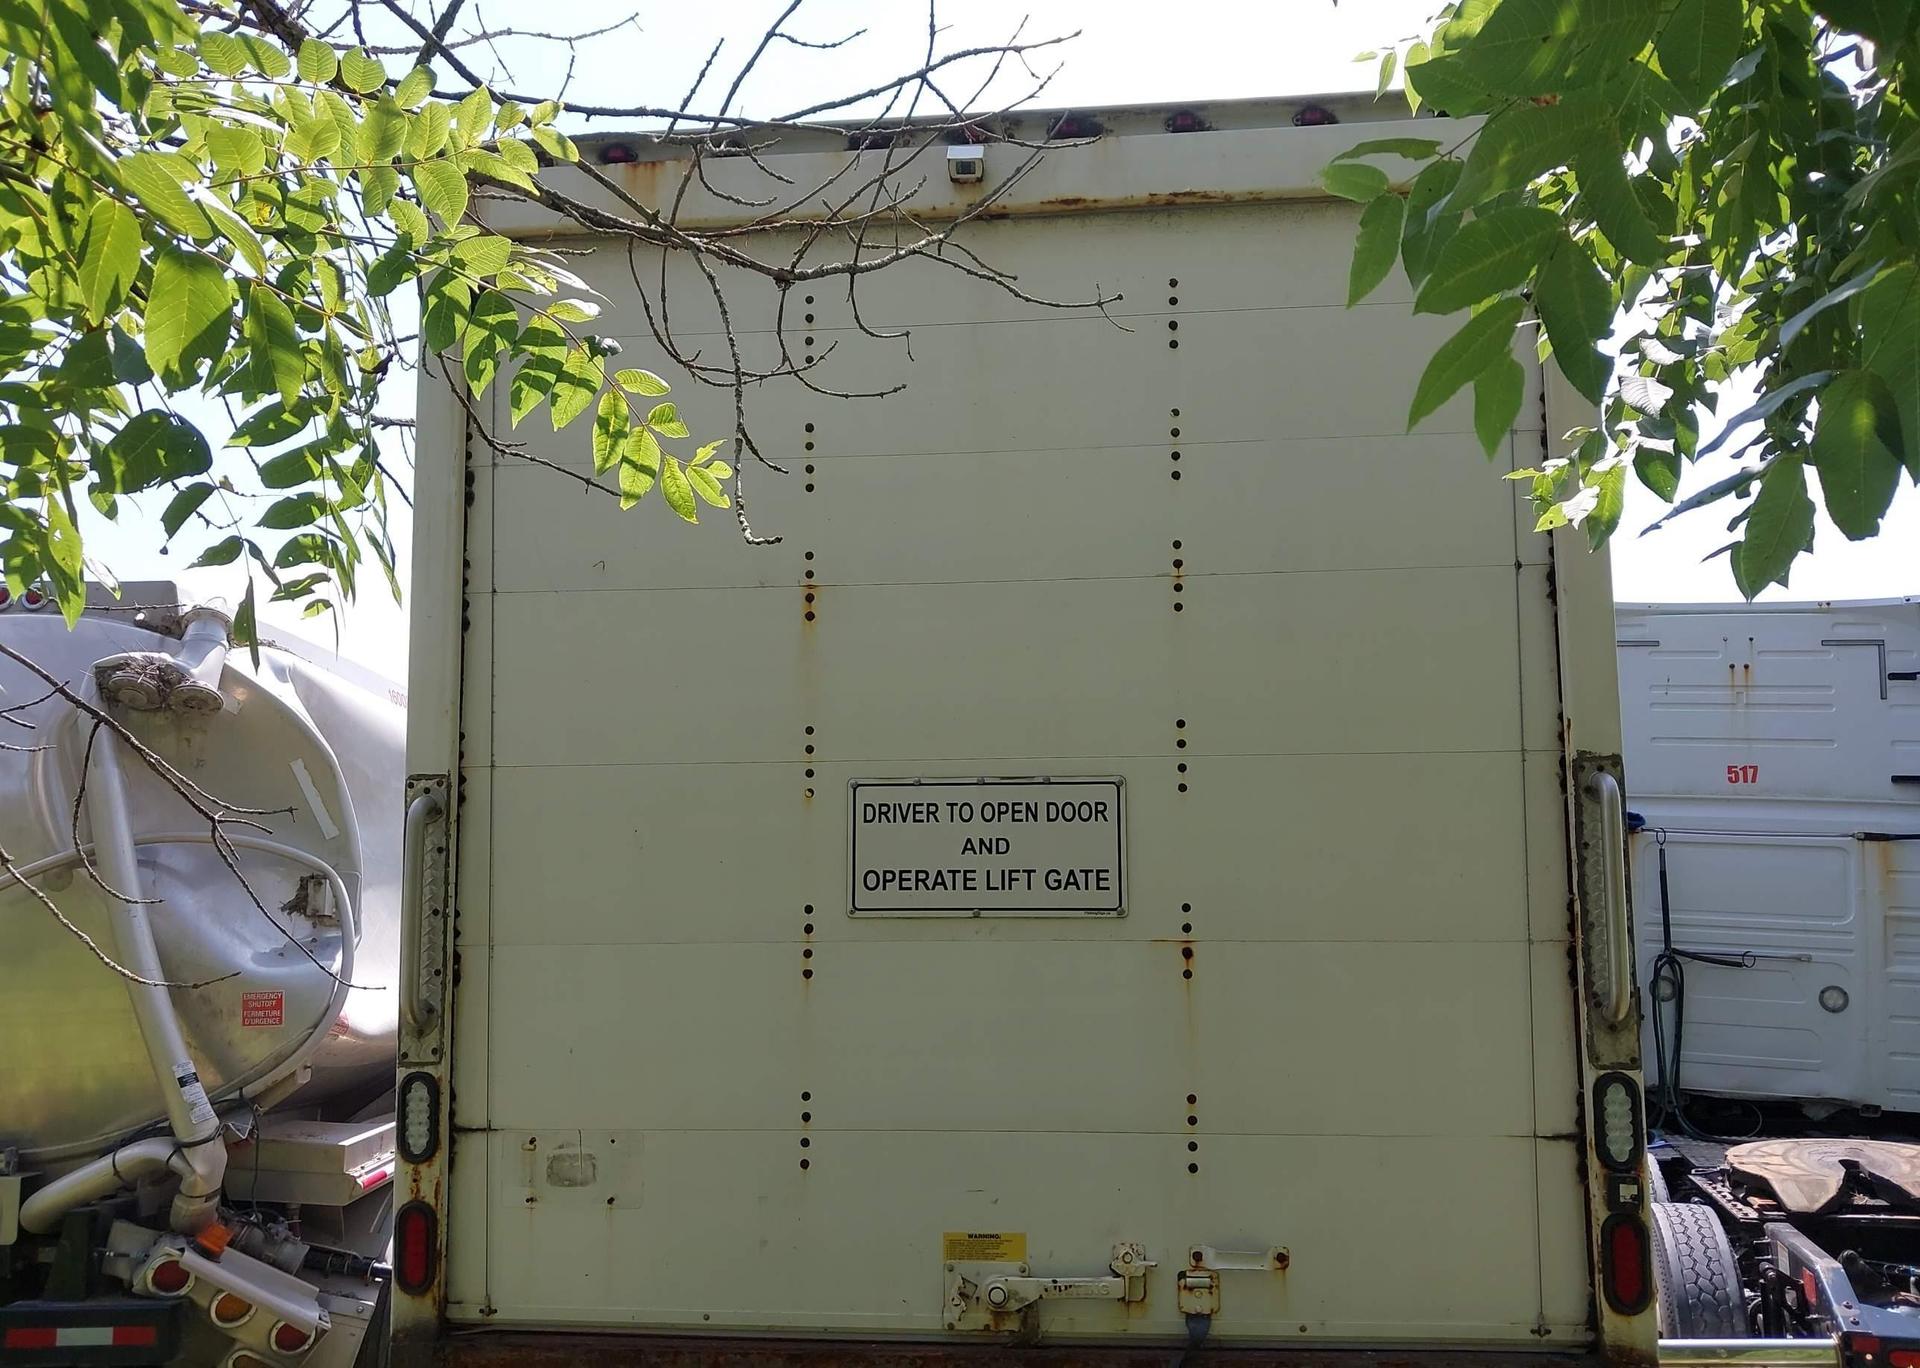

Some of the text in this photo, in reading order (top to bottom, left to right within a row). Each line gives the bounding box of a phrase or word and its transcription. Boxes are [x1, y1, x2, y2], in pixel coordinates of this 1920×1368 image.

[1727, 765, 1759, 784] 517
[863, 801, 1109, 824] DRIVER TO OPEN DOOR
[961, 837, 1010, 856] AND
[863, 869, 1111, 892] OPERATE LIFT GATE
[243, 992, 282, 1000] EMERGENCY
